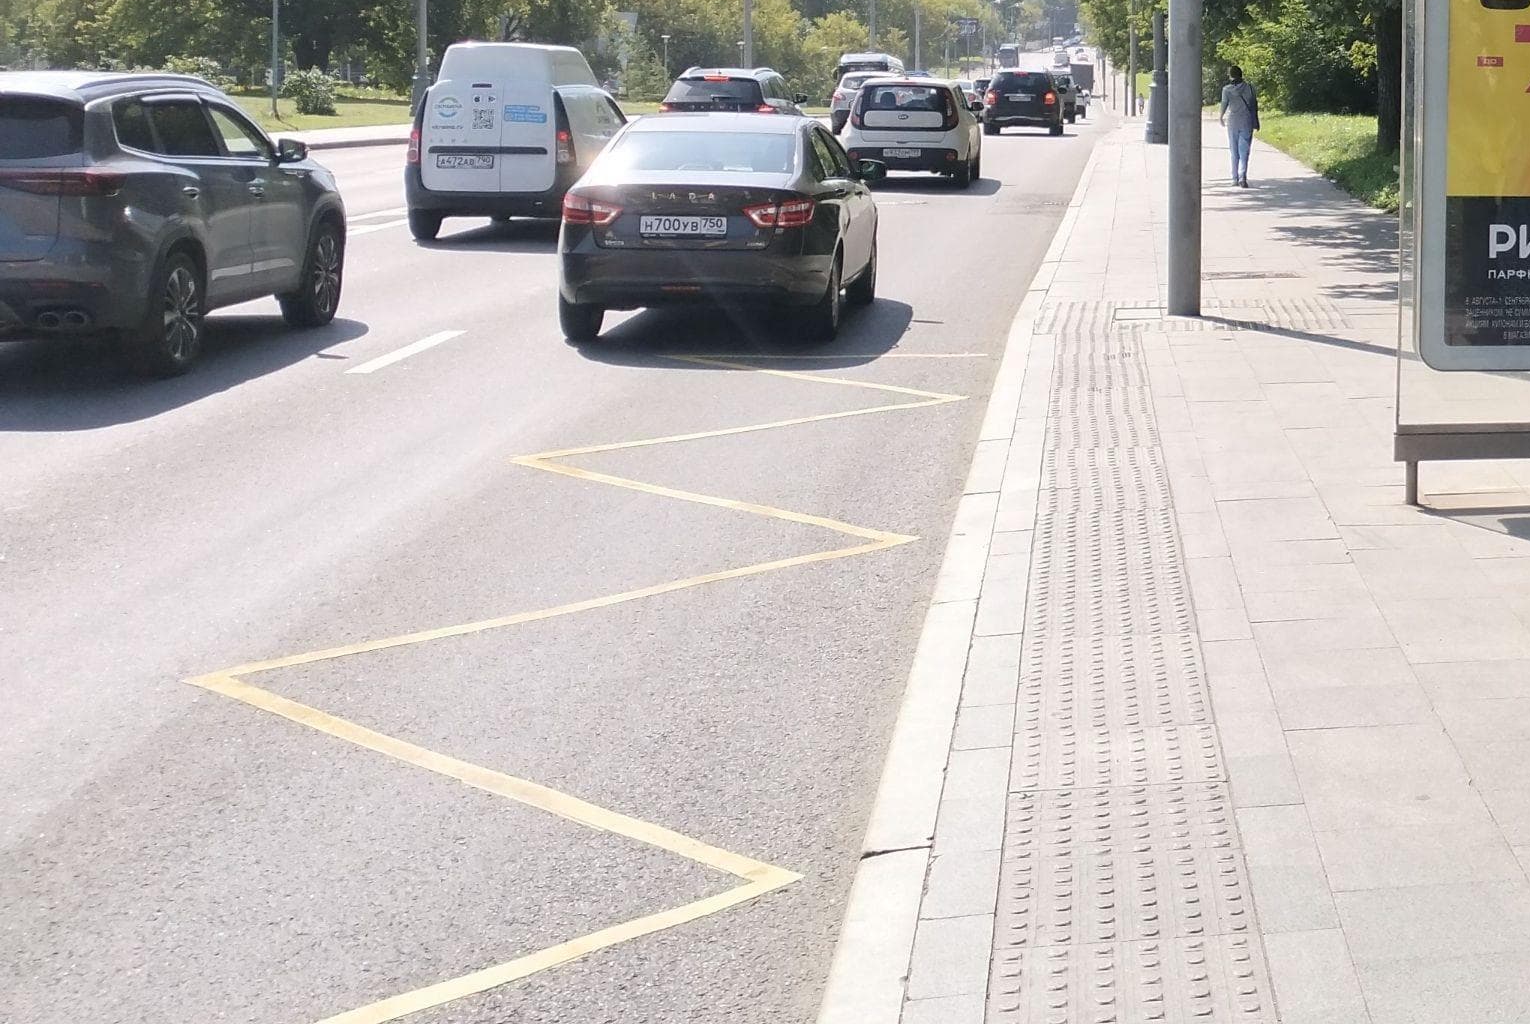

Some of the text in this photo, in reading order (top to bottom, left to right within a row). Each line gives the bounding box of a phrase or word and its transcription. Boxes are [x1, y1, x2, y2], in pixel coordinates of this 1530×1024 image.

[651, 191, 715, 202] LADA
[644, 218, 724, 233] Н700УВ 750
